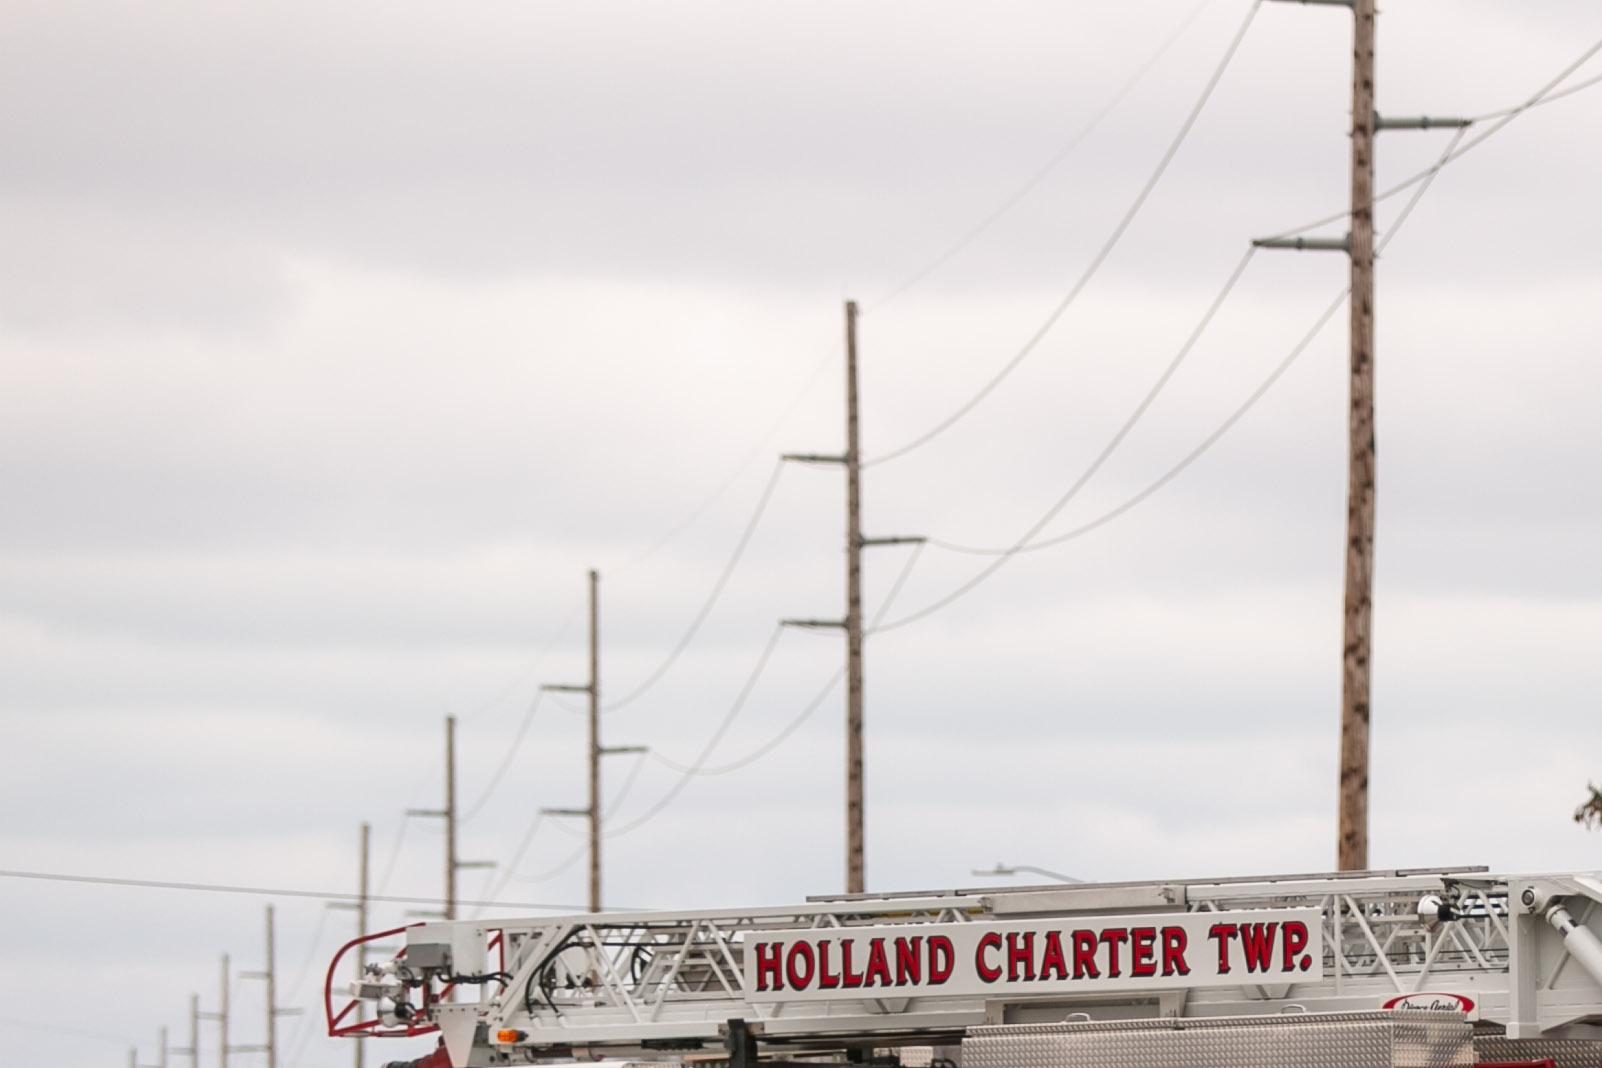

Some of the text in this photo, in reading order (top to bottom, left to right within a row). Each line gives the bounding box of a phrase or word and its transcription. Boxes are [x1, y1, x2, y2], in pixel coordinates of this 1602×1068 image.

[755, 920, 1313, 993] HOLLAND CHARTER TWP.
